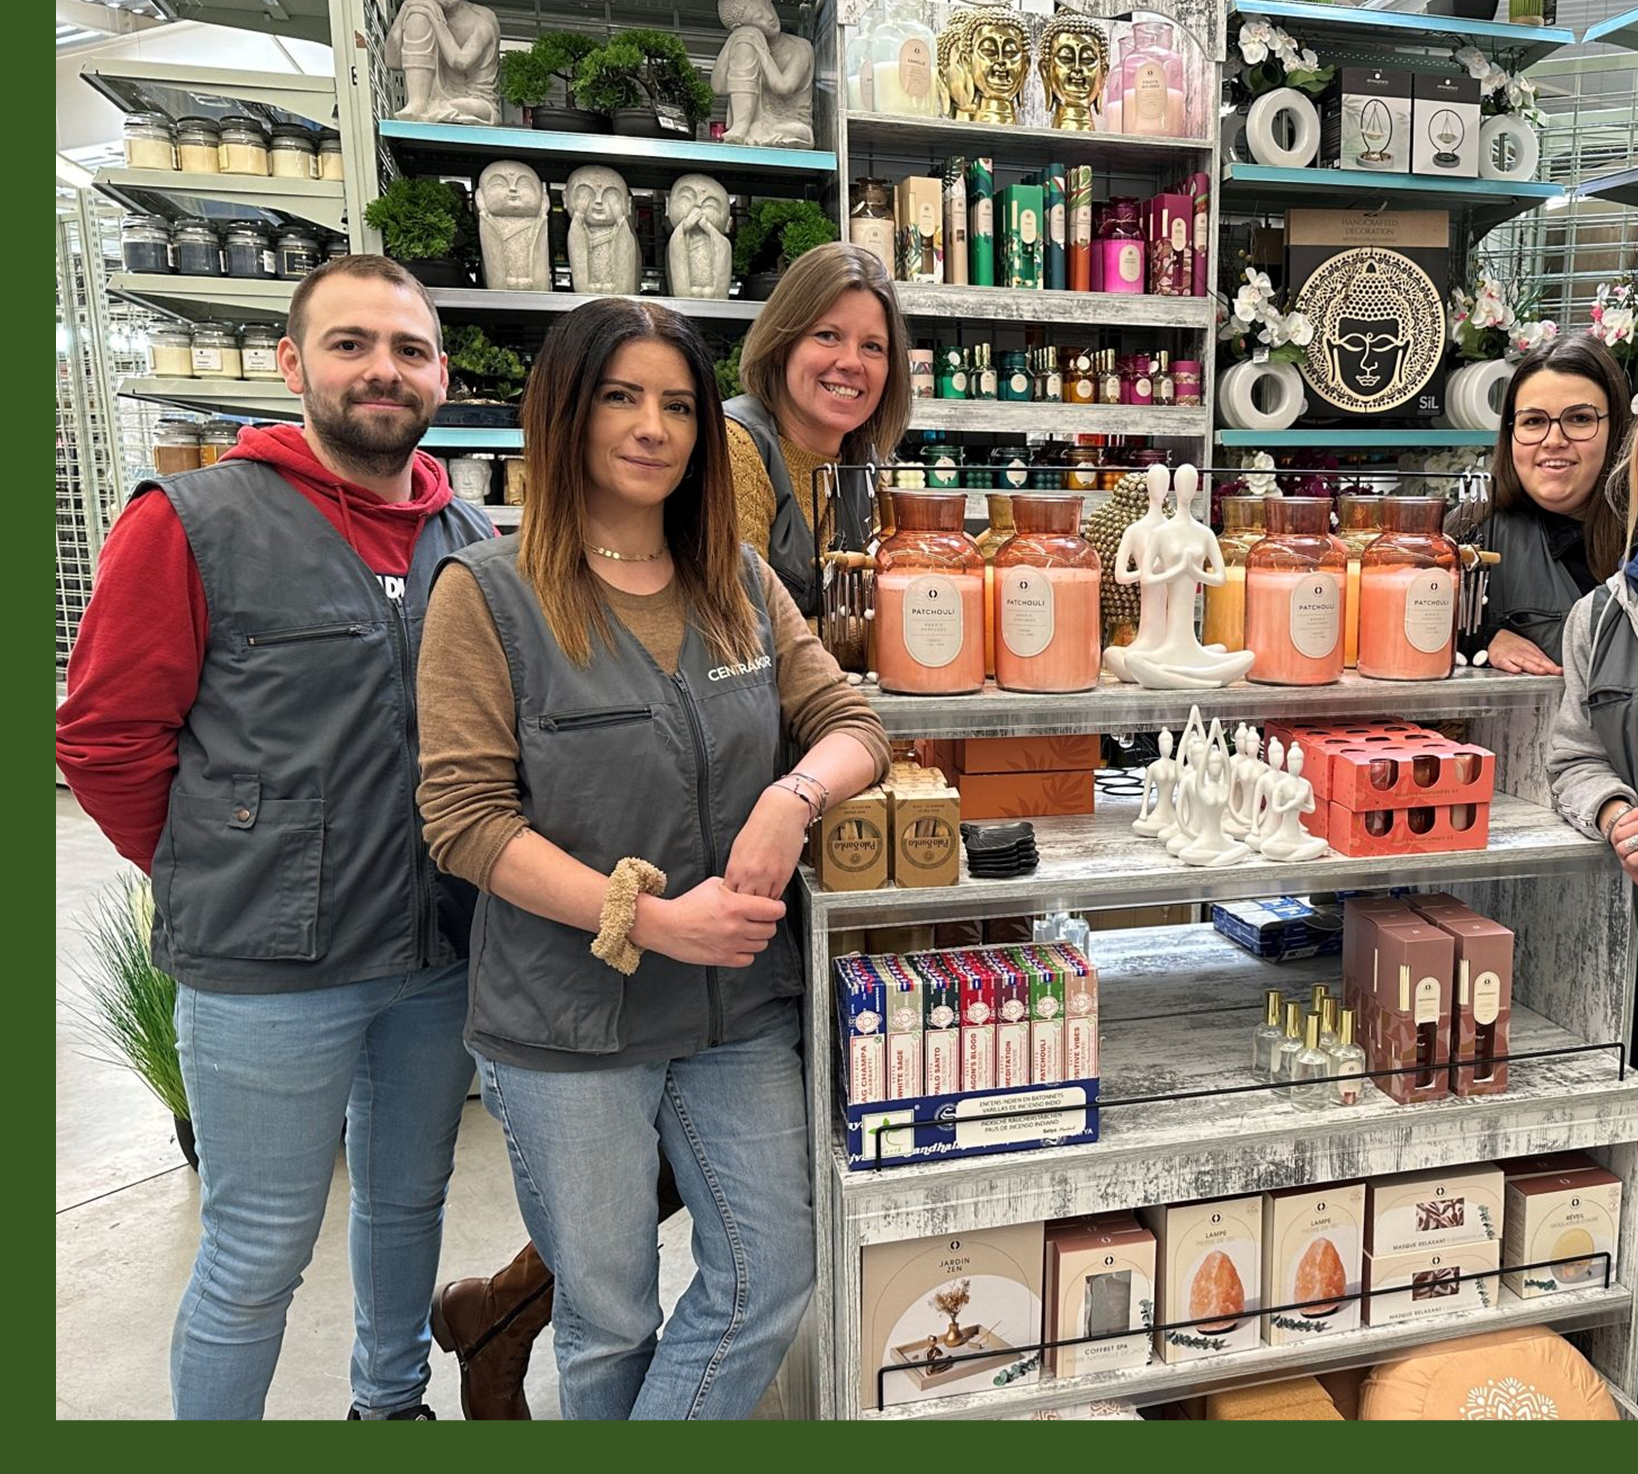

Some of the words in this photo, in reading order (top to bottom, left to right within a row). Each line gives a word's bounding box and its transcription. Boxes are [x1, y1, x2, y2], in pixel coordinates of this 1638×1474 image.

[1341, 218, 1398, 227] HANDCRAFTED
[1007, 598, 1045, 607] PATCHOULI
[911, 608, 955, 616] PATCHOULI
[982, 1105, 1008, 1114] VARILLAS
[1311, 1218, 1331, 1227] LAMPE
[1205, 1229, 1227, 1239] LAMPE
[1393, 1242, 1417, 1250] MASQUE
[1418, 1238, 1446, 1248] RELAXANT
[939, 1257, 971, 1269] JARDIN
[946, 1265, 963, 1273] ZEN
[1389, 1311, 1413, 1320] MASQUE
[1414, 1307, 1442, 1317] RELAXANT
[1085, 1344, 1115, 1356] COFFRET
[1115, 1343, 1128, 1352] SPA
